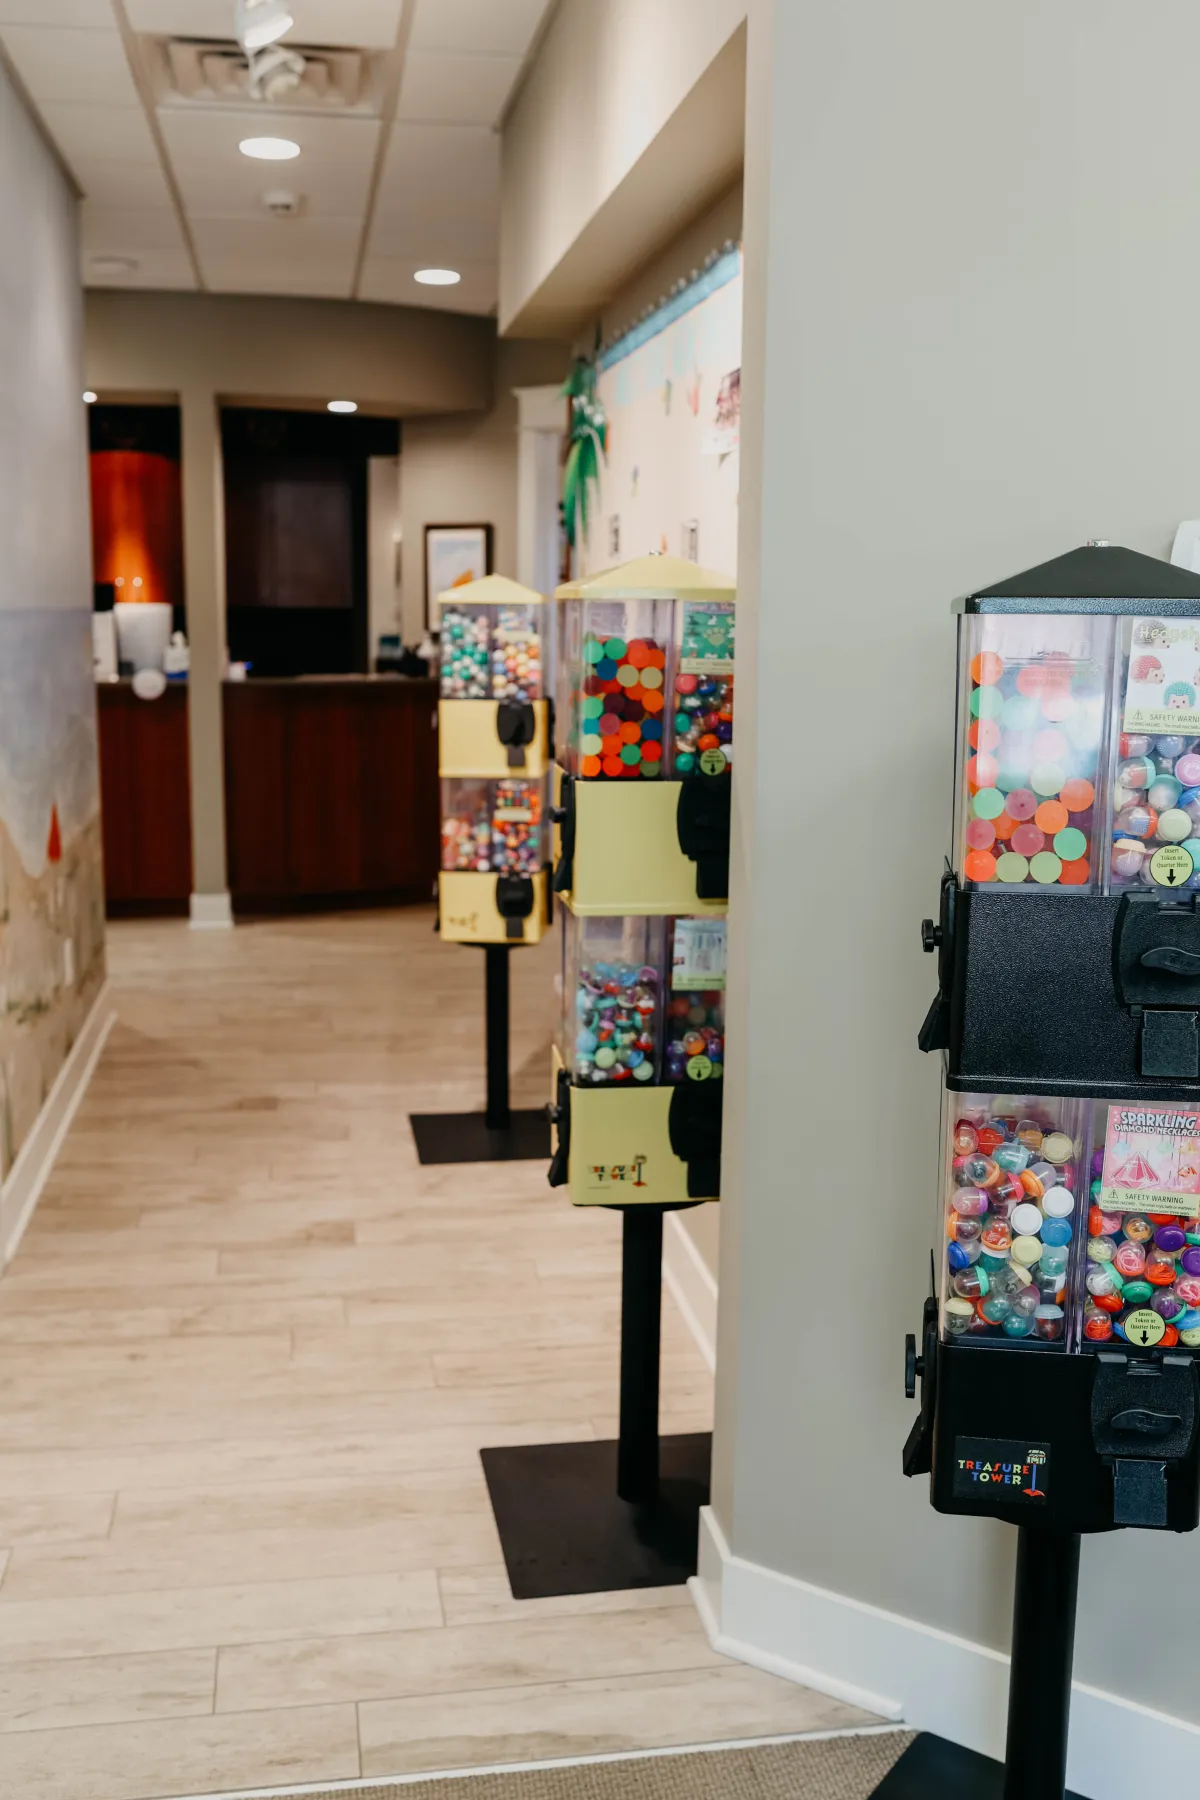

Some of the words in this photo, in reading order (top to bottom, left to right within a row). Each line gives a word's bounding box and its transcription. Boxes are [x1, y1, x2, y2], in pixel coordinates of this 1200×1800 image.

[1150, 713, 1176, 721] SAFETY
[1120, 1111, 1198, 1130] SPARKLING
[1114, 1124, 1155, 1135] DIAMOND
[1156, 1127, 1200, 1137] NECKLACES
[1125, 1192, 1150, 1201] SAFETY
[1151, 1195, 1184, 1204] WARNING
[958, 1459, 1029, 1475] TREASURE
[971, 1471, 1022, 1485] TOWER
